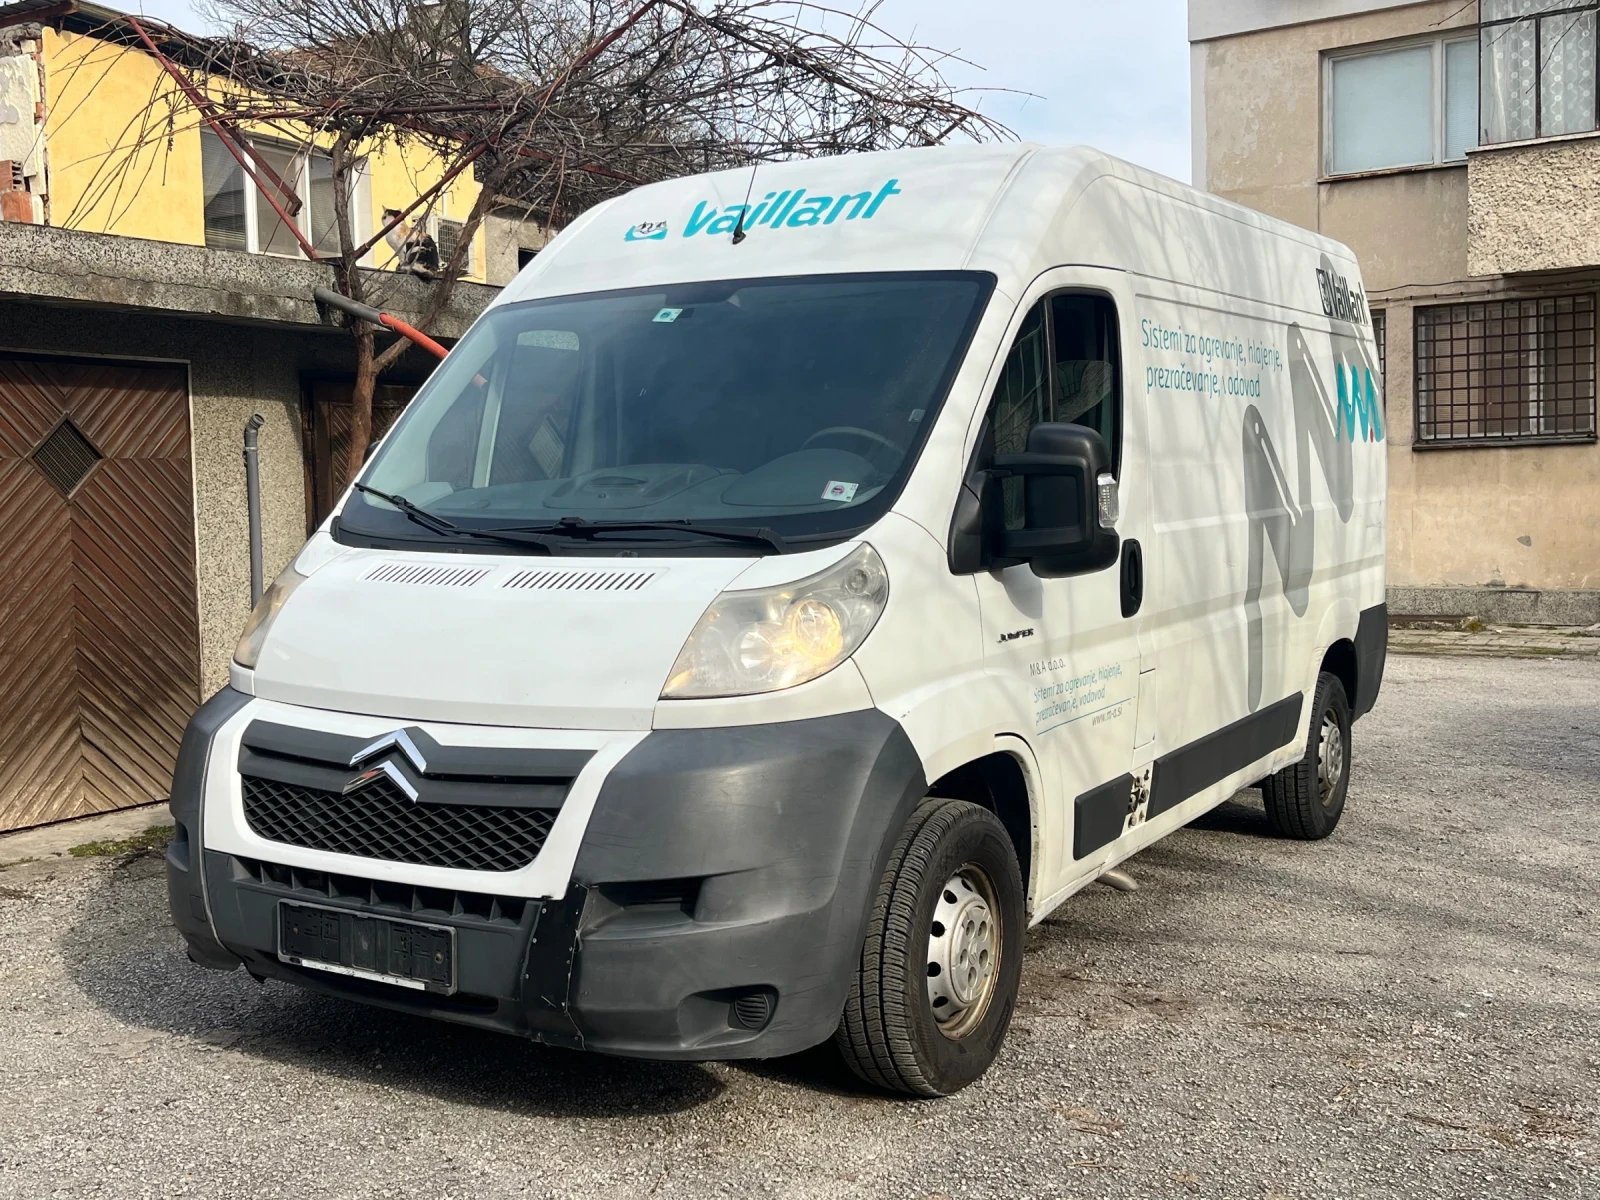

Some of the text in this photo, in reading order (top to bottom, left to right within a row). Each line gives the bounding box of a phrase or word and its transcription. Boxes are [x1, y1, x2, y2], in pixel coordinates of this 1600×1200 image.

[683, 179, 902, 238] Vaillant
[1325, 270, 1368, 325] Vaillant
[1141, 318, 1283, 371] Sistemi za ogrevanje, hlajenje,
[1146, 362, 1220, 399] prezračevanje,
[1029, 657, 1066, 677] M&A d.o.o.
[1056, 682, 1064, 695] za
[1065, 669, 1098, 695] ogrevanje,
[1079, 684, 1105, 706] vodovod
